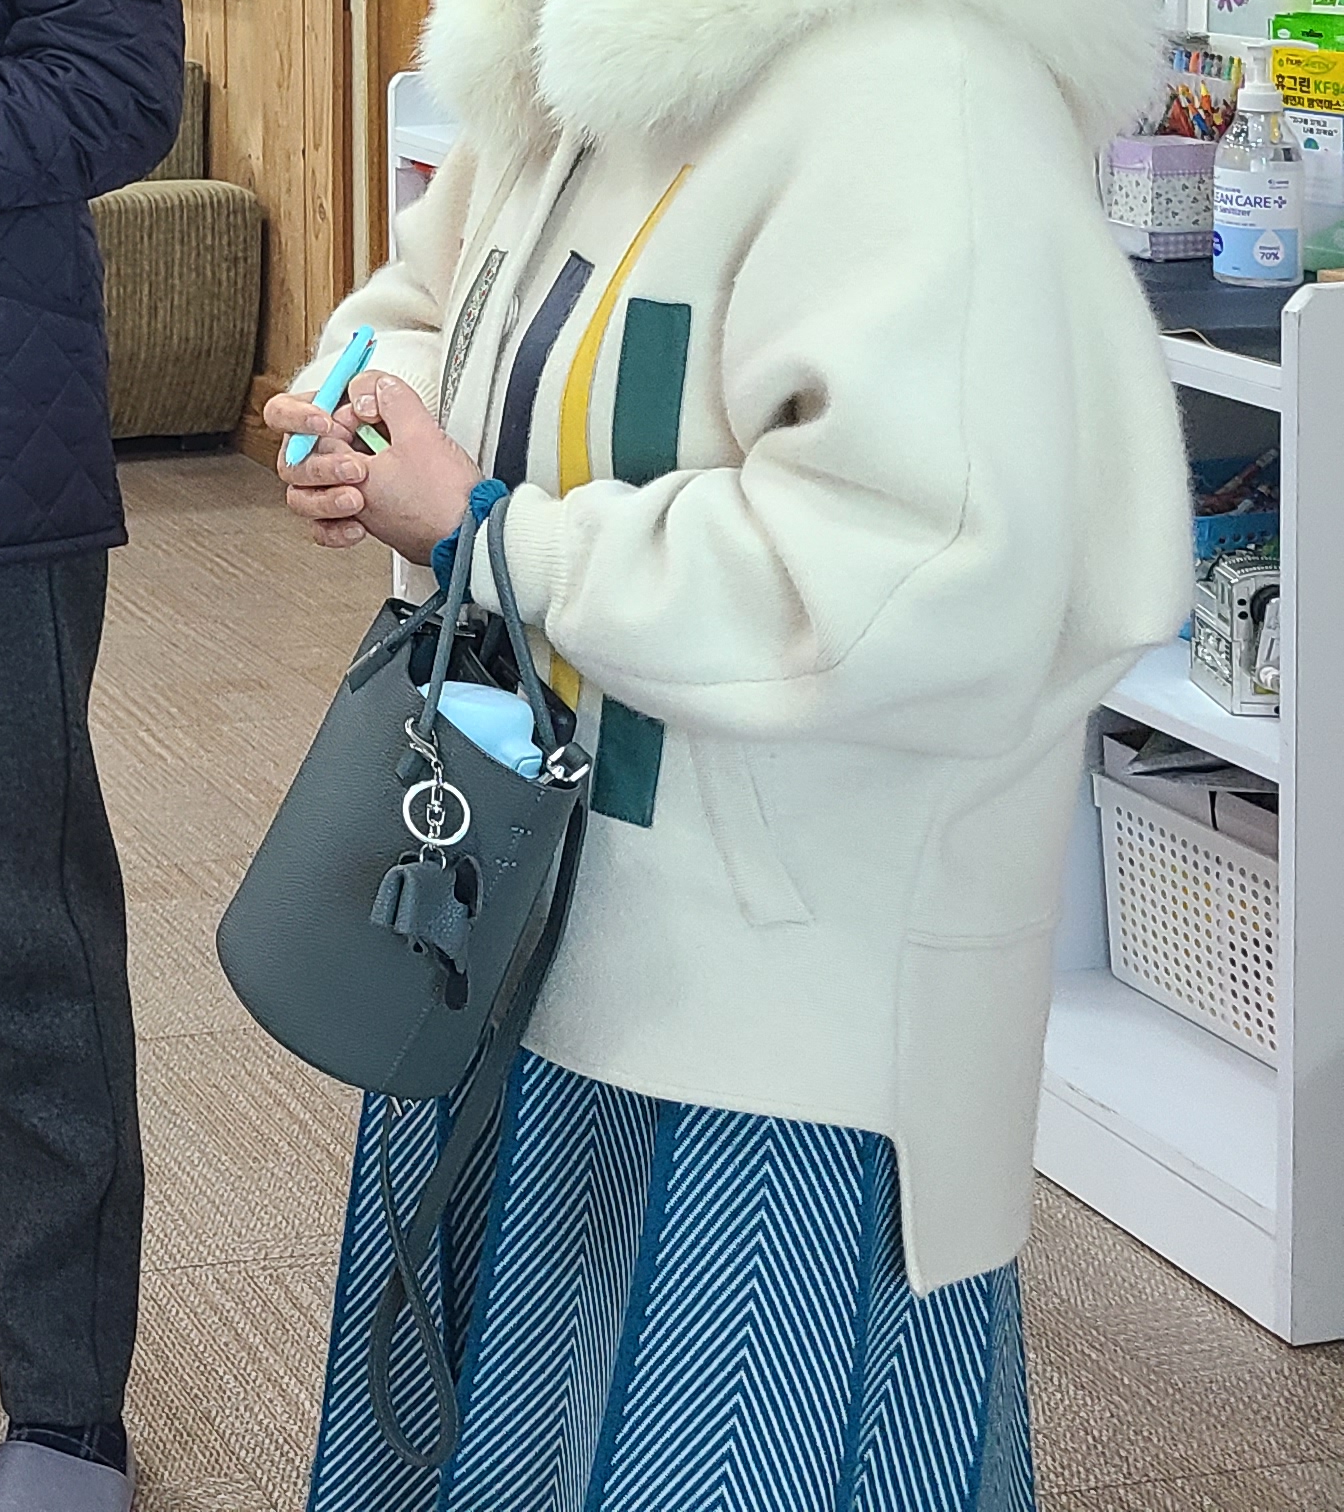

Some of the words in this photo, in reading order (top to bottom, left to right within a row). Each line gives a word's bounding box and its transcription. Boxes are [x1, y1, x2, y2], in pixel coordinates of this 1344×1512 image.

[1275, 73, 1311, 94] 휴그린
[1235, 194, 1273, 209] CARE
[1259, 251, 1280, 261] 70%
